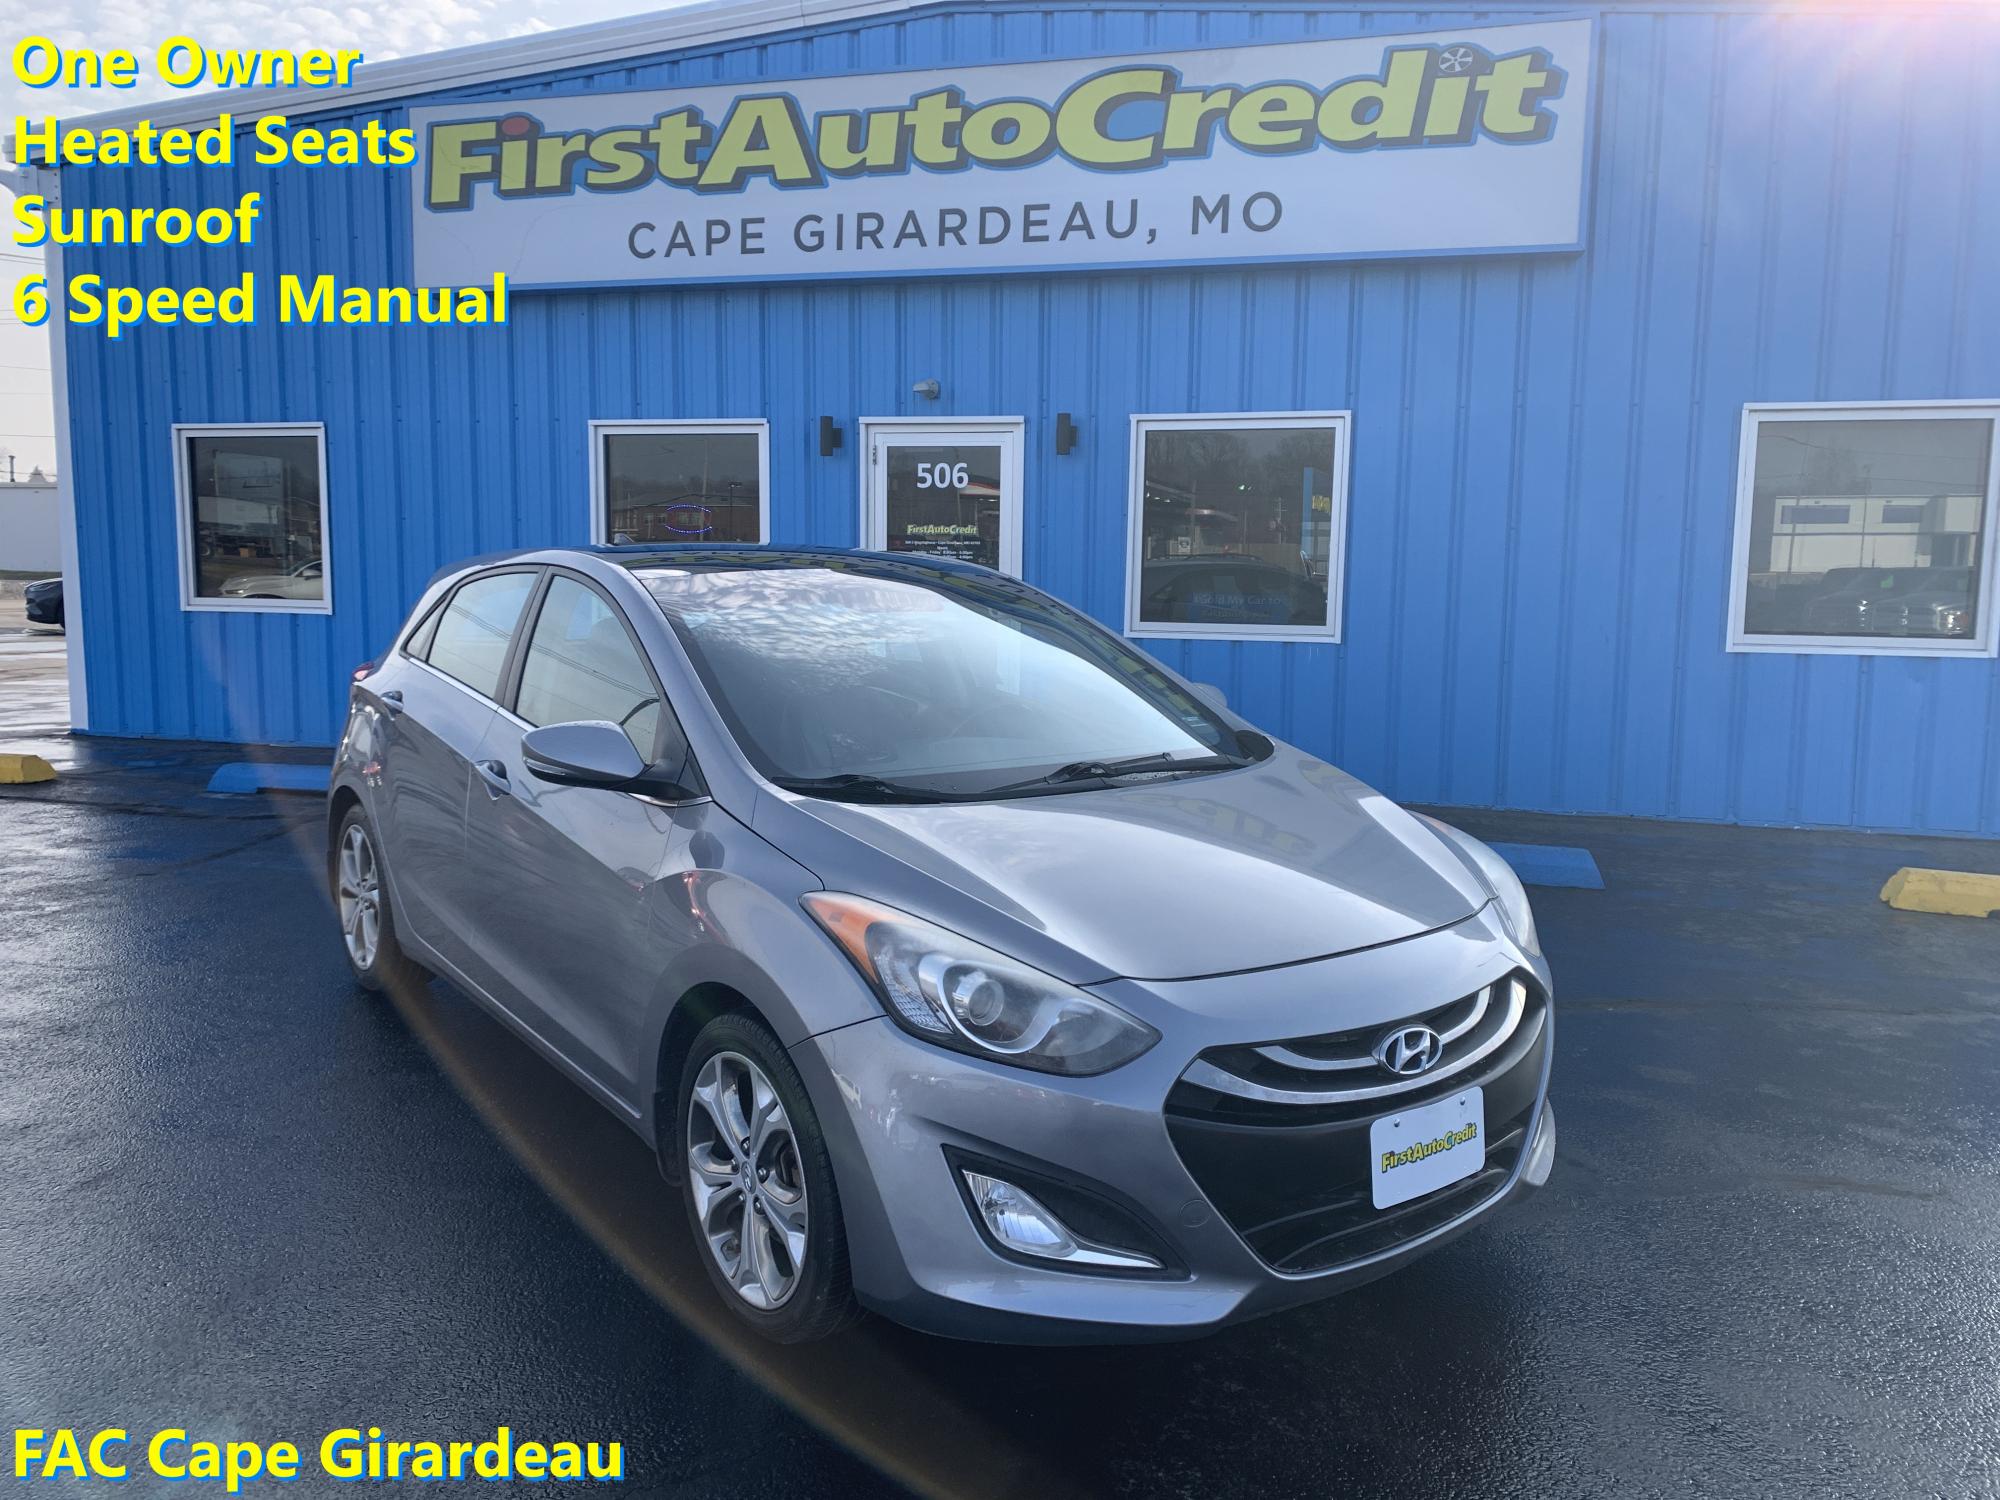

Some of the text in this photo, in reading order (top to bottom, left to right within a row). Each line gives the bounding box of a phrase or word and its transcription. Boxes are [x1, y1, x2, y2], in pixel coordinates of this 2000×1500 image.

[424, 44, 1568, 213] FirstAutoCredit
[627, 191, 1284, 260] CAPE GIRARDEAU, MO
[916, 462, 969, 489] 506
[906, 524, 978, 535] FirstAutoCredit
[1381, 1122, 1477, 1173] FirstAutoCredit
